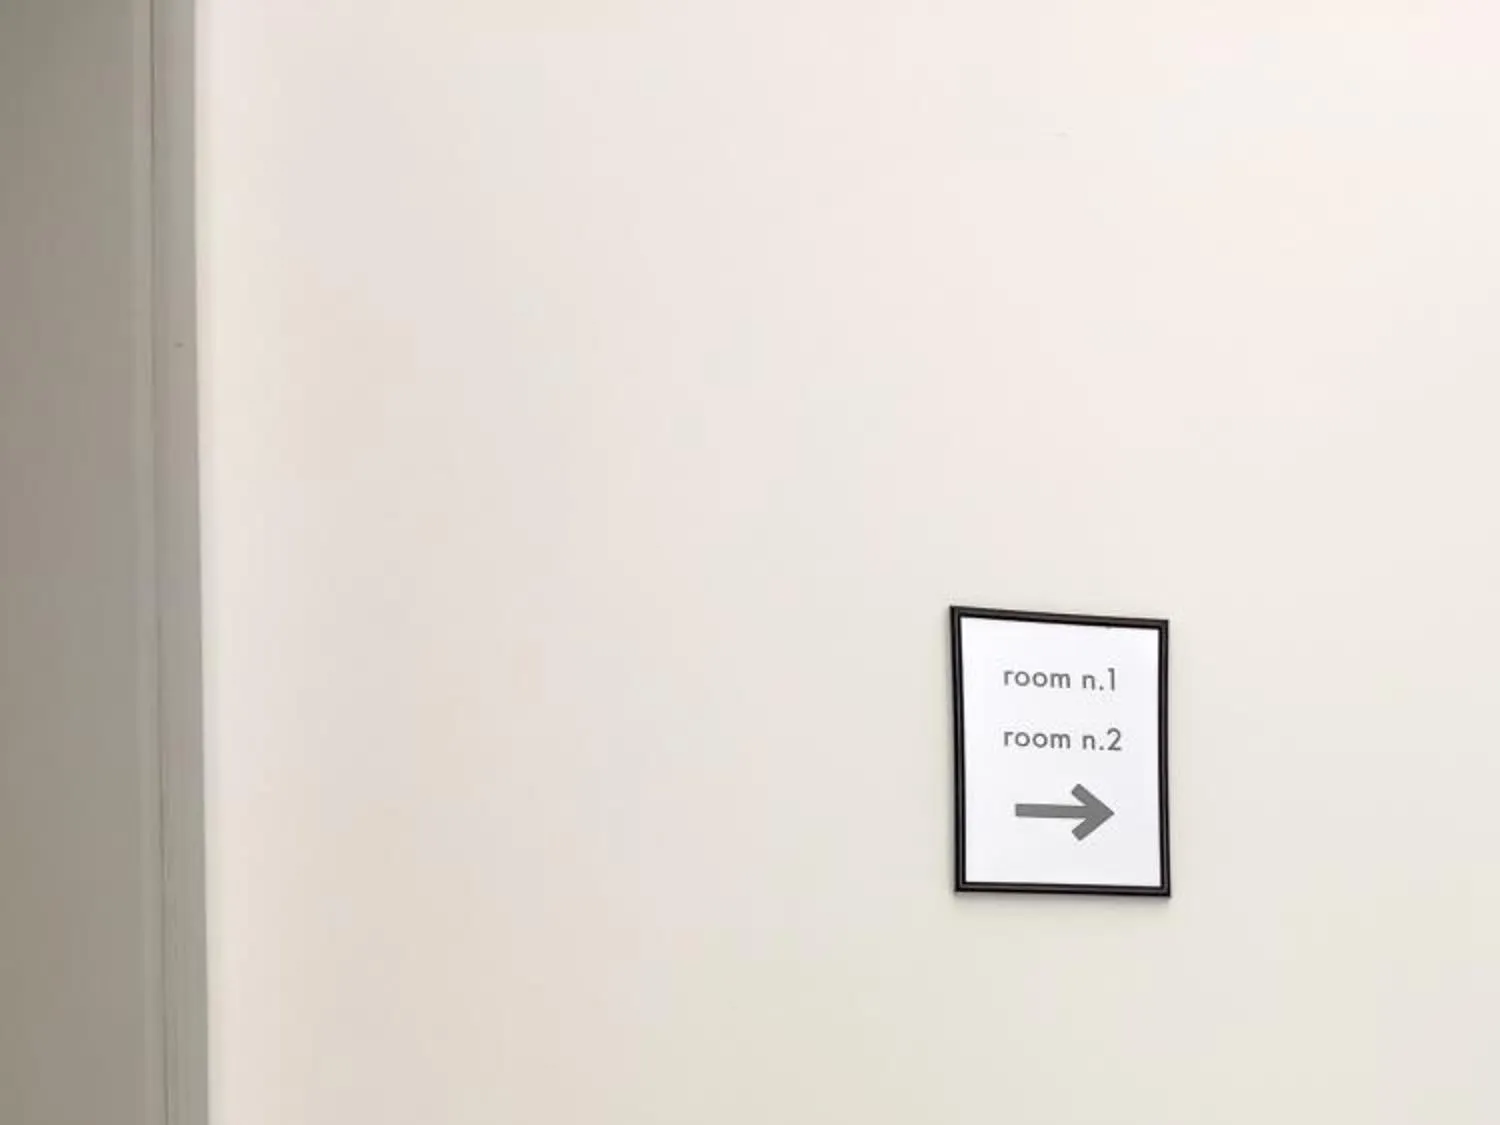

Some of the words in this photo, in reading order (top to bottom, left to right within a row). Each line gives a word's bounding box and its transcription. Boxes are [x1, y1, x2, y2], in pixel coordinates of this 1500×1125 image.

[1003, 670, 1071, 689] room
[1081, 667, 1115, 691] n.1
[1003, 731, 1071, 749] room
[1081, 727, 1122, 751] n.2
